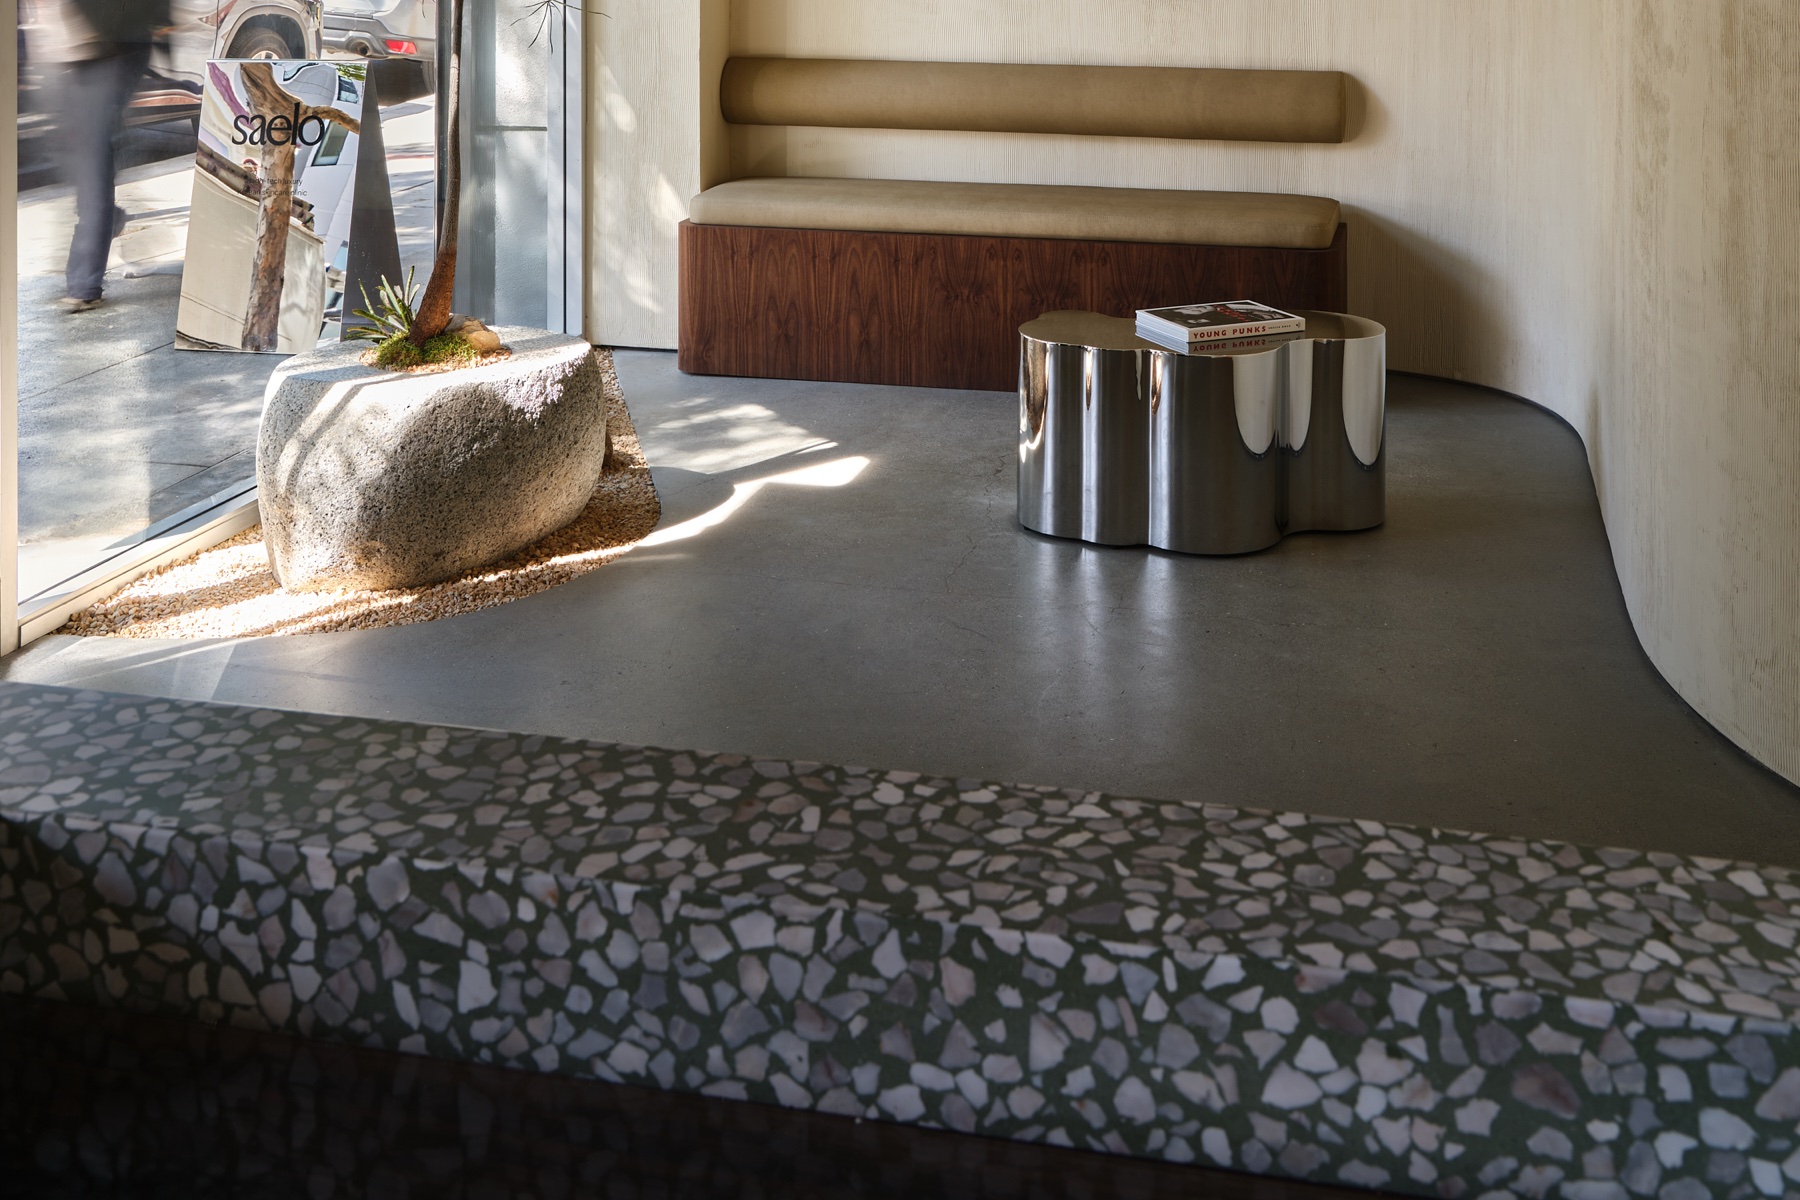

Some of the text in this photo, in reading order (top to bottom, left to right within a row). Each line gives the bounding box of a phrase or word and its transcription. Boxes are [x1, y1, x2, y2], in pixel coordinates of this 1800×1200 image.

[231, 102, 325, 146] saelo
[282, 177, 303, 188] luxury
[1193, 329, 1227, 339] YOUNG
[1232, 325, 1266, 335] PUNKS
